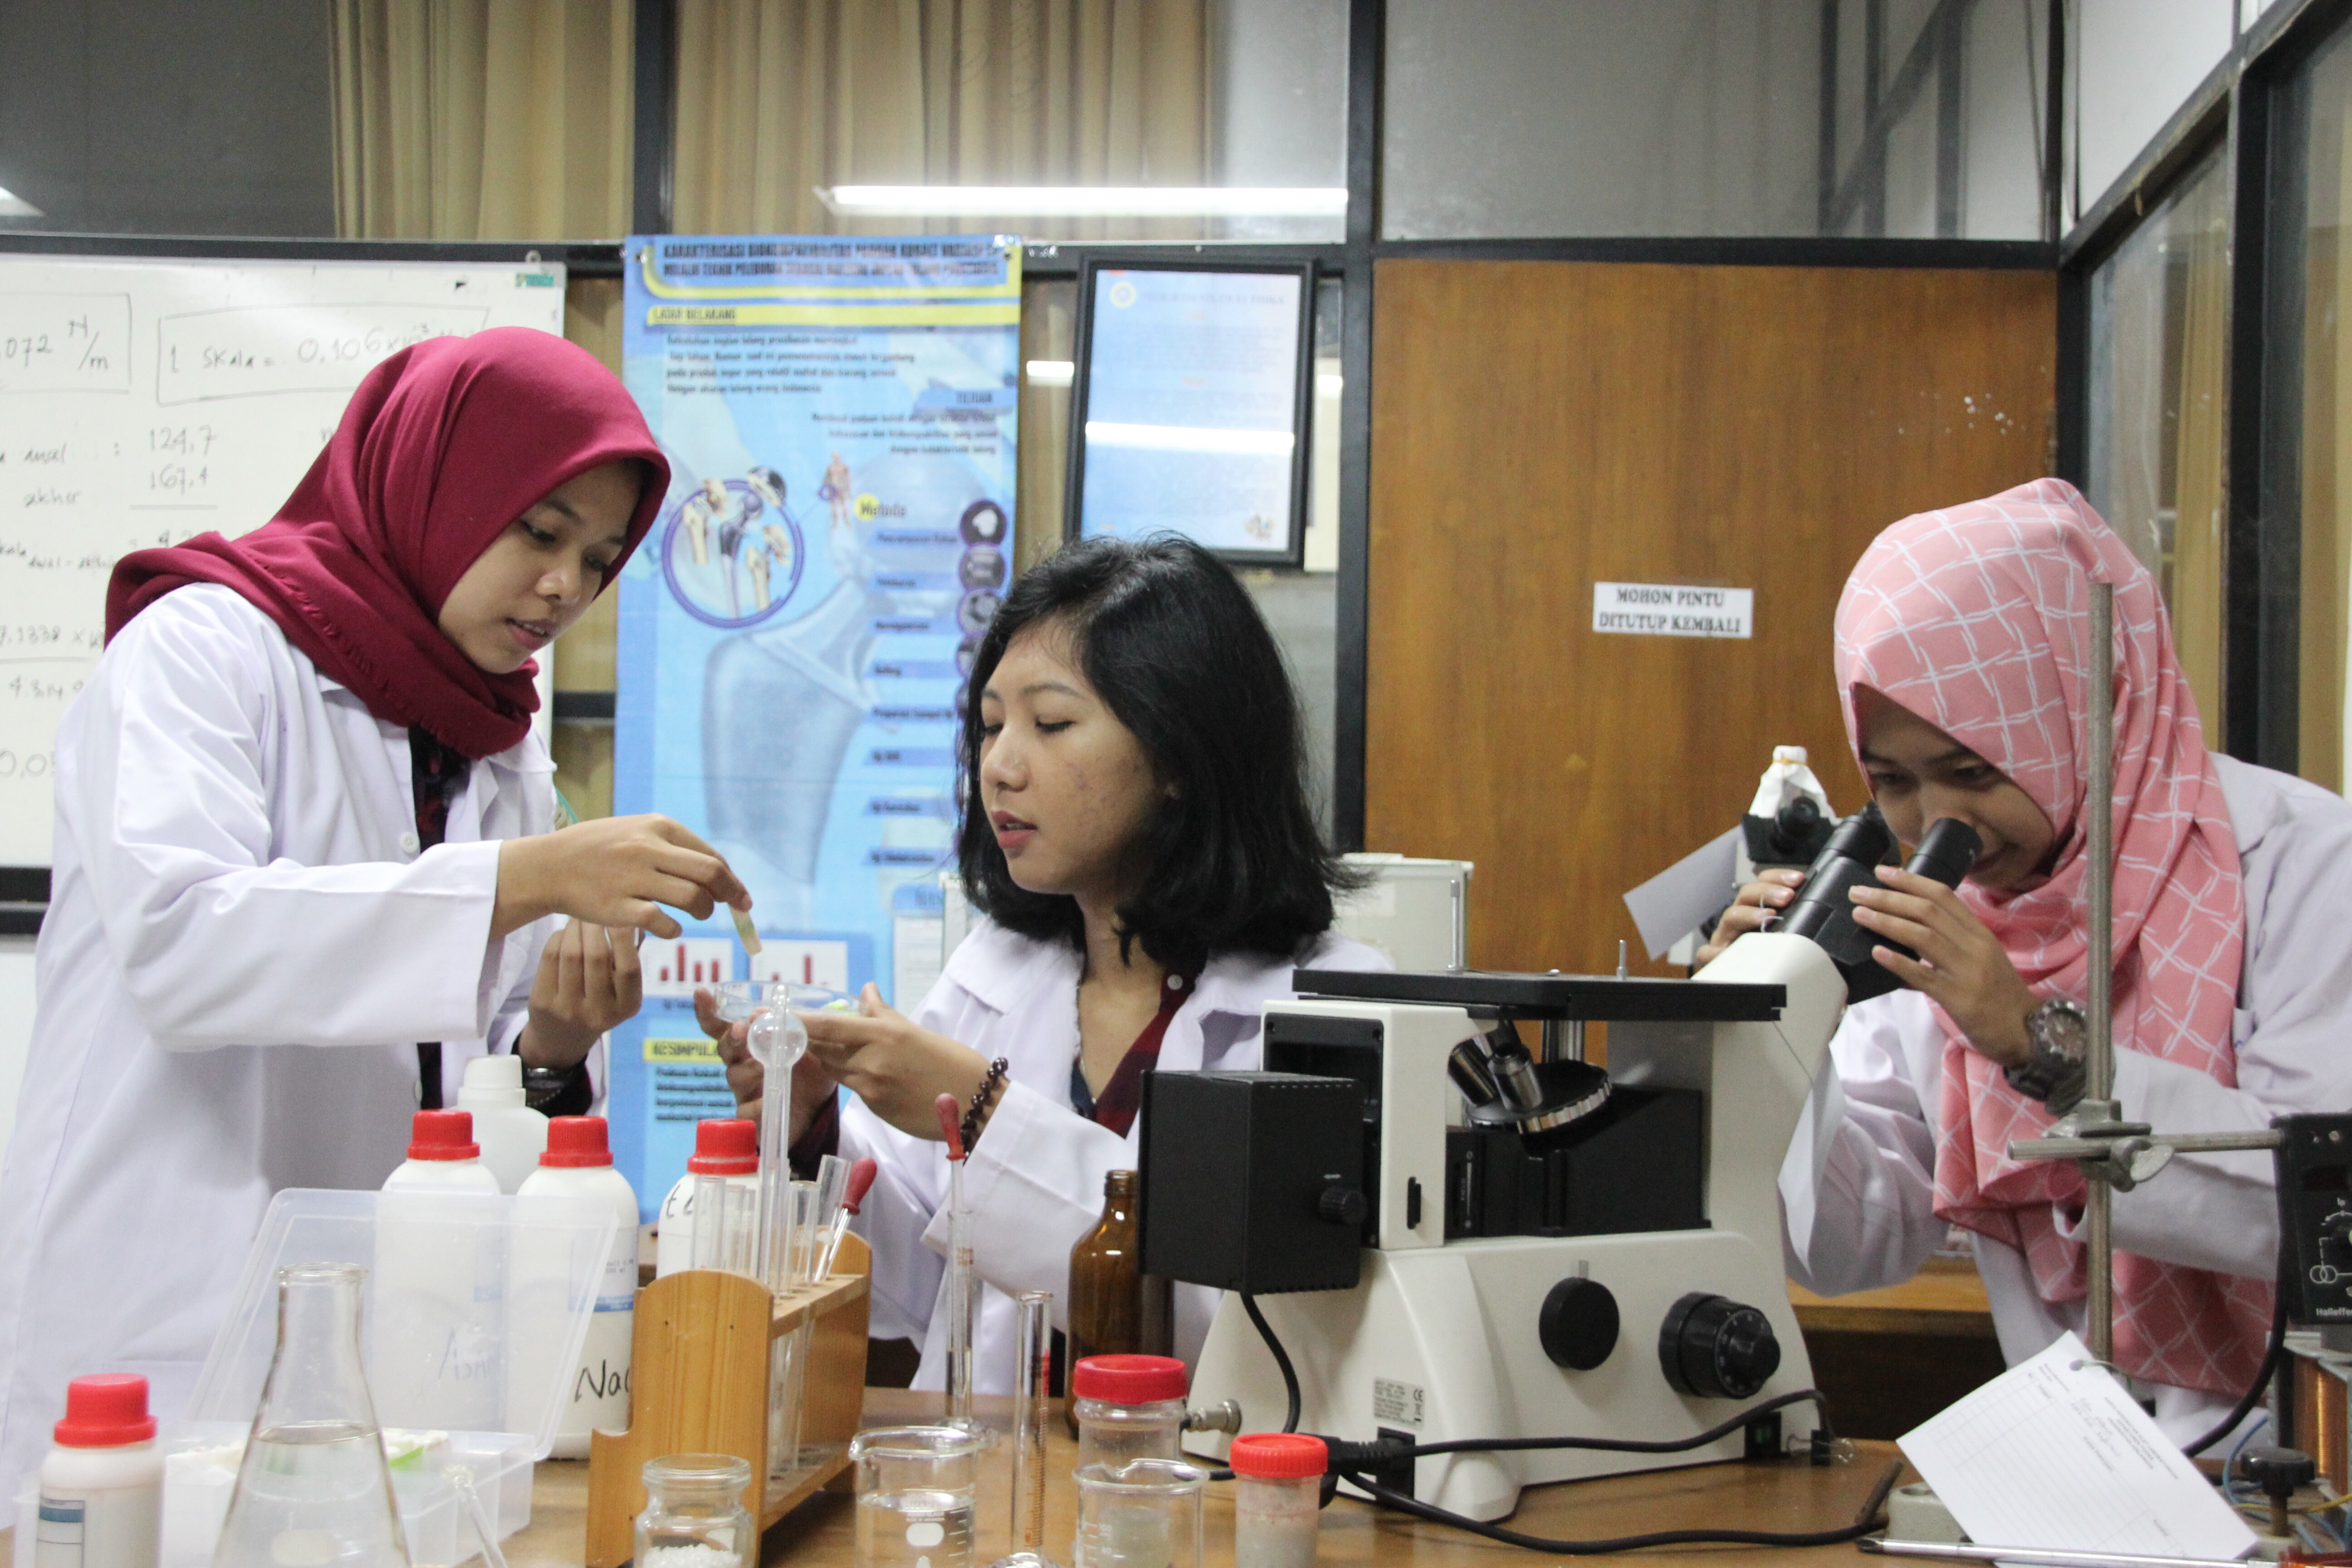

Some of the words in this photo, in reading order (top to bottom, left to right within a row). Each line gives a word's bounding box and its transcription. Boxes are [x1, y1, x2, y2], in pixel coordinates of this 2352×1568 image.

[1617, 587, 1672, 604] MOHON
[1677, 591, 1725, 607] PINTU
[1599, 612, 1667, 629] DITUTUP
[1671, 615, 1741, 633] KEMBALI
